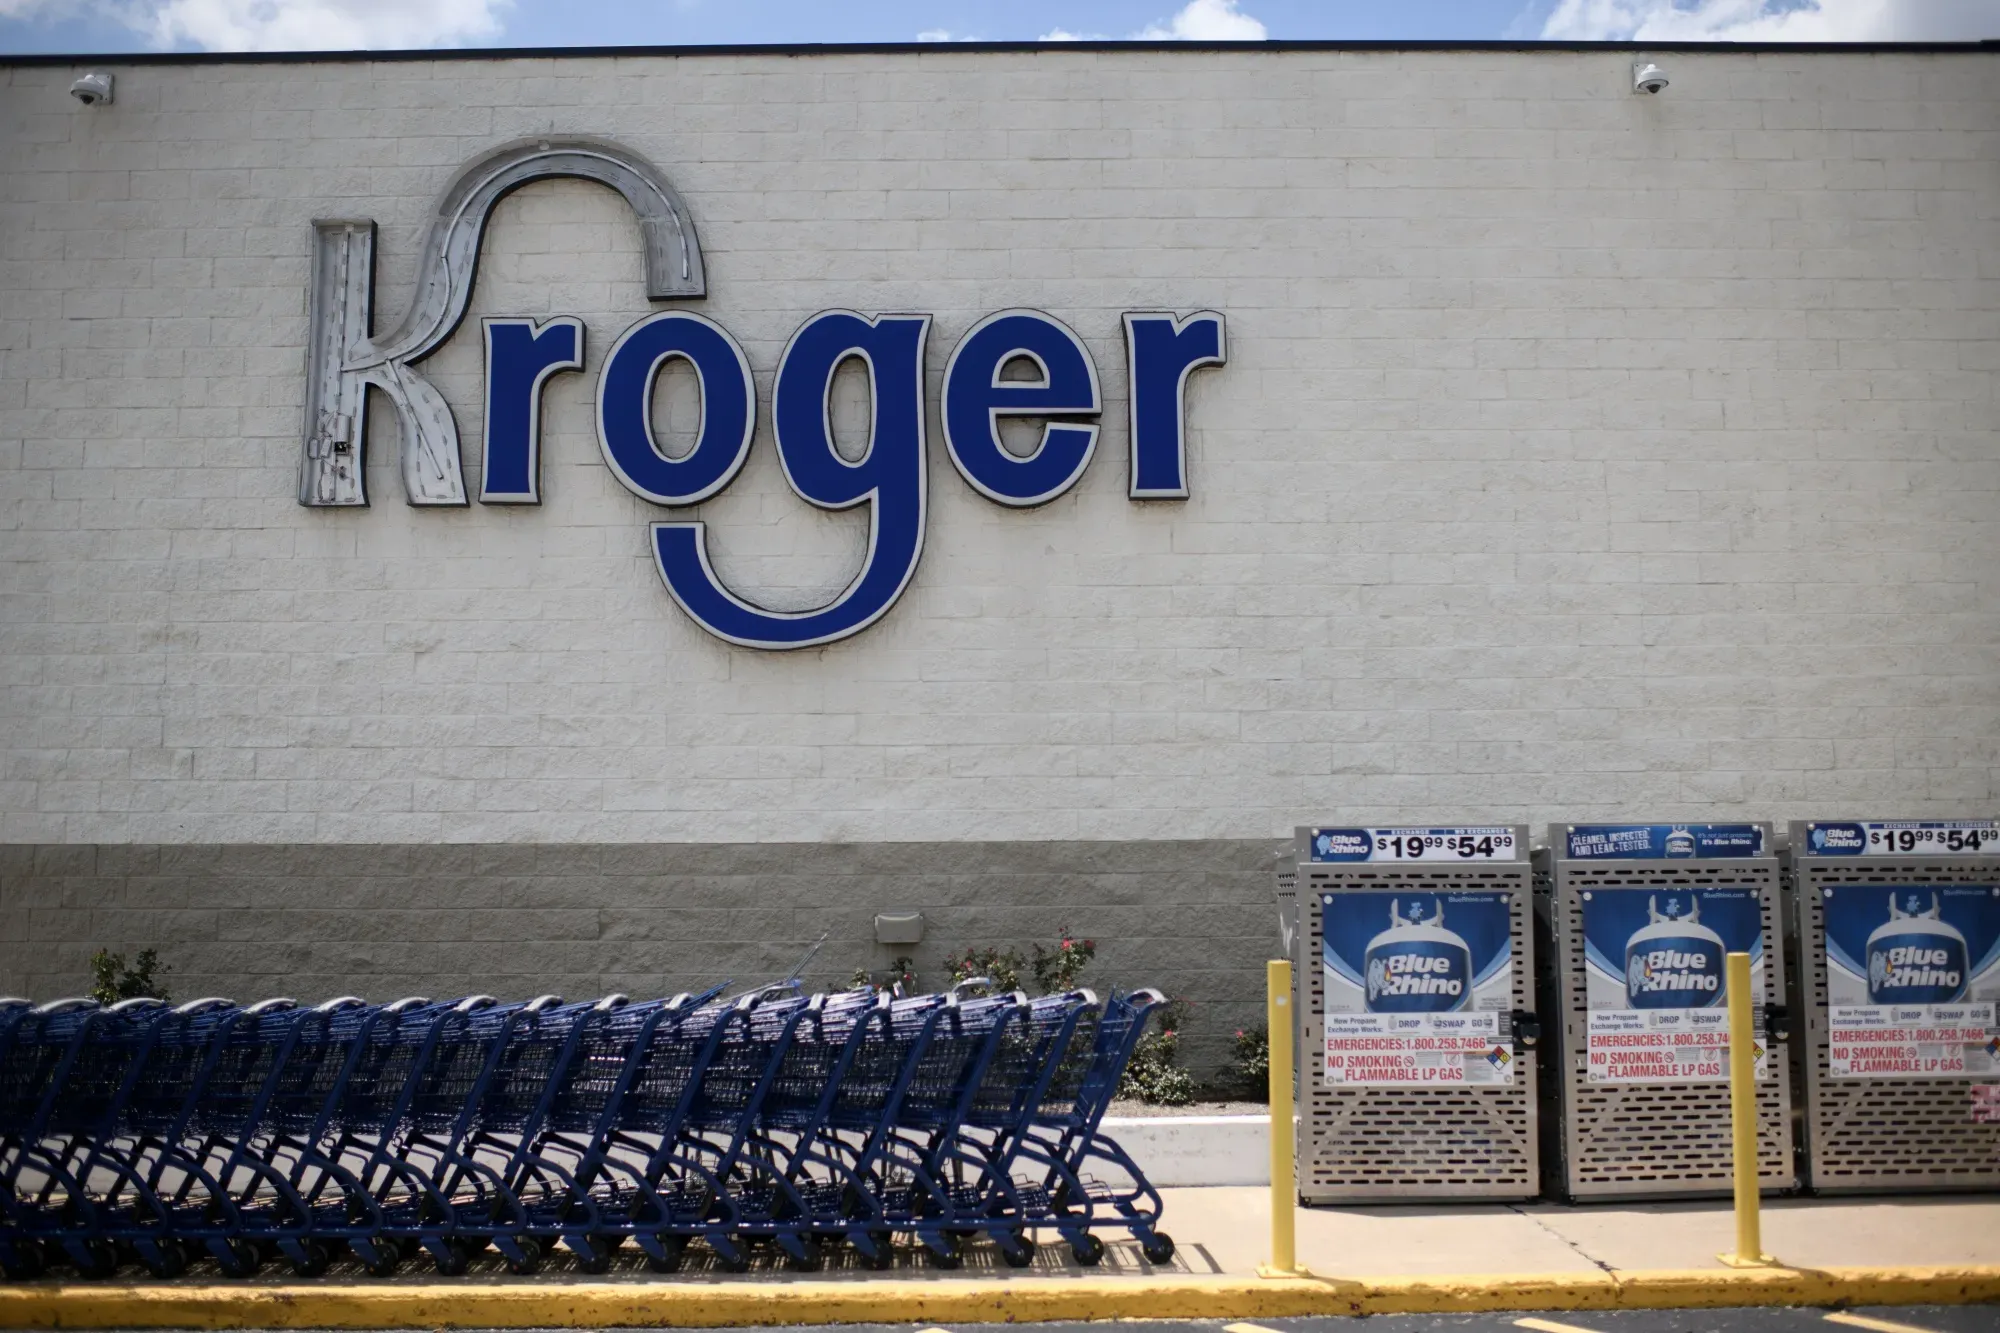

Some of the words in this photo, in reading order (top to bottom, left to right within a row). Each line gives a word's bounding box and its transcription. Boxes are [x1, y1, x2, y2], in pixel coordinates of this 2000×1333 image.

[298, 134, 1227, 651] Kroger
[1608, 830, 1650, 842] INSPECTED.
[1826, 829, 1856, 838] Blue
[1331, 835, 1362, 845] Blue
[1575, 845, 1591, 856] AND
[1648, 950, 1706, 970] Blue
[1888, 946, 1948, 965] Blue
[1388, 953, 1449, 974] Blue
[1642, 969, 1718, 992] Rhino
[1884, 966, 1960, 988] Rhino
[1382, 974, 1462, 996] Rhino
[1612, 1014, 1639, 1022] Propane
[1854, 1009, 1880, 1017] Propane
[1900, 1011, 1922, 1020] DROP
[1942, 1011, 1964, 1020] SWAP
[1970, 1010, 1981, 1018] GO
[1333, 1017, 1348, 1025] How
[1350, 1017, 1377, 1025] Propane
[1398, 1019, 1421, 1028] DROP
[1442, 1019, 1466, 1028] SWAP
[1471, 1019, 1482, 1027] GO
[1658, 1015, 1680, 1024] DROP
[1700, 1015, 1722, 1024] SWAP
[1832, 1018, 1863, 1026] Exchange
[1327, 1026, 1359, 1034] Exchange
[1590, 1052, 1606, 1065] NO
[1610, 1051, 1663, 1064] SMOKING
[1832, 1047, 1849, 1060] NO
[1851, 1046, 1905, 1059] SMOKING
[1327, 1055, 1344, 1068] NO
[1347, 1055, 1402, 1068] SMOKING
[1850, 1059, 1921, 1073] FLAMMABLE
[1924, 1059, 1938, 1071] LP
[1941, 1058, 1963, 1071] GAS
[1345, 1068, 1419, 1081] FLAMMABLE
[1422, 1068, 1436, 1081] LP
[1439, 1068, 1463, 1081] GAS
[1607, 1064, 1679, 1078] FLAMMABLE
[1681, 1063, 1695, 1076] LP
[1698, 1063, 1720, 1076] GAS
